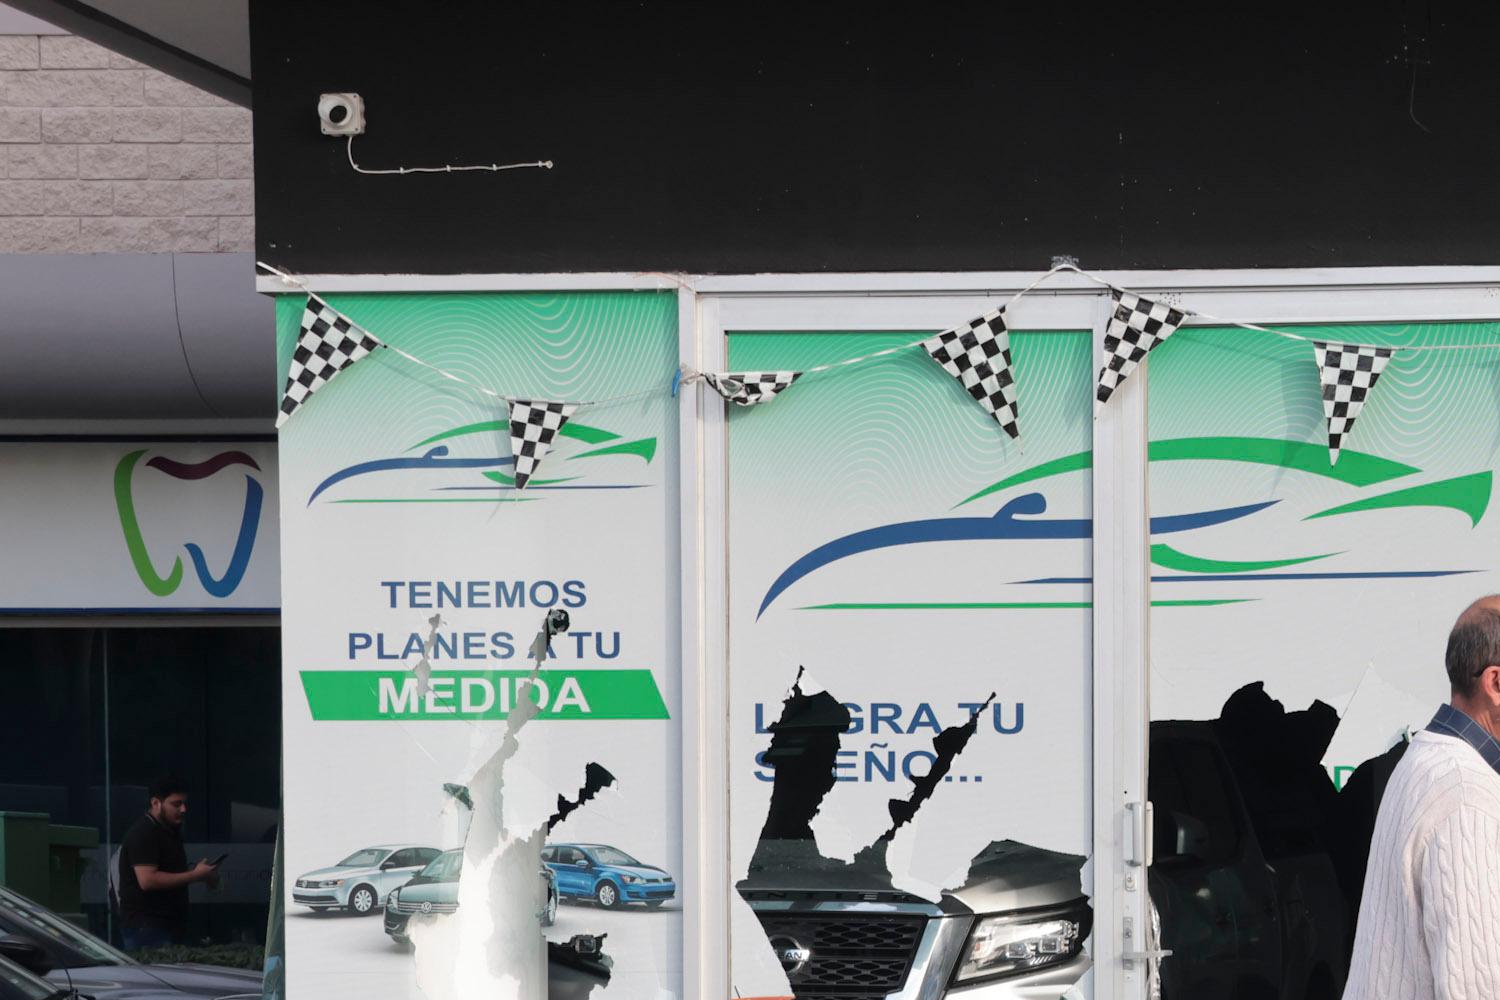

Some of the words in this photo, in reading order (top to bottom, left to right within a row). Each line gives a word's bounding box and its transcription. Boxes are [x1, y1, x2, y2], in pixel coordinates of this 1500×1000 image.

[381, 580, 587, 609] TENEMOS
[348, 632, 515, 660] PLANES
[567, 631, 621, 659] TU
[378, 677, 591, 713] MEDIDA
[755, 703, 942, 734] LGRA
[958, 703, 1024, 734] TU
